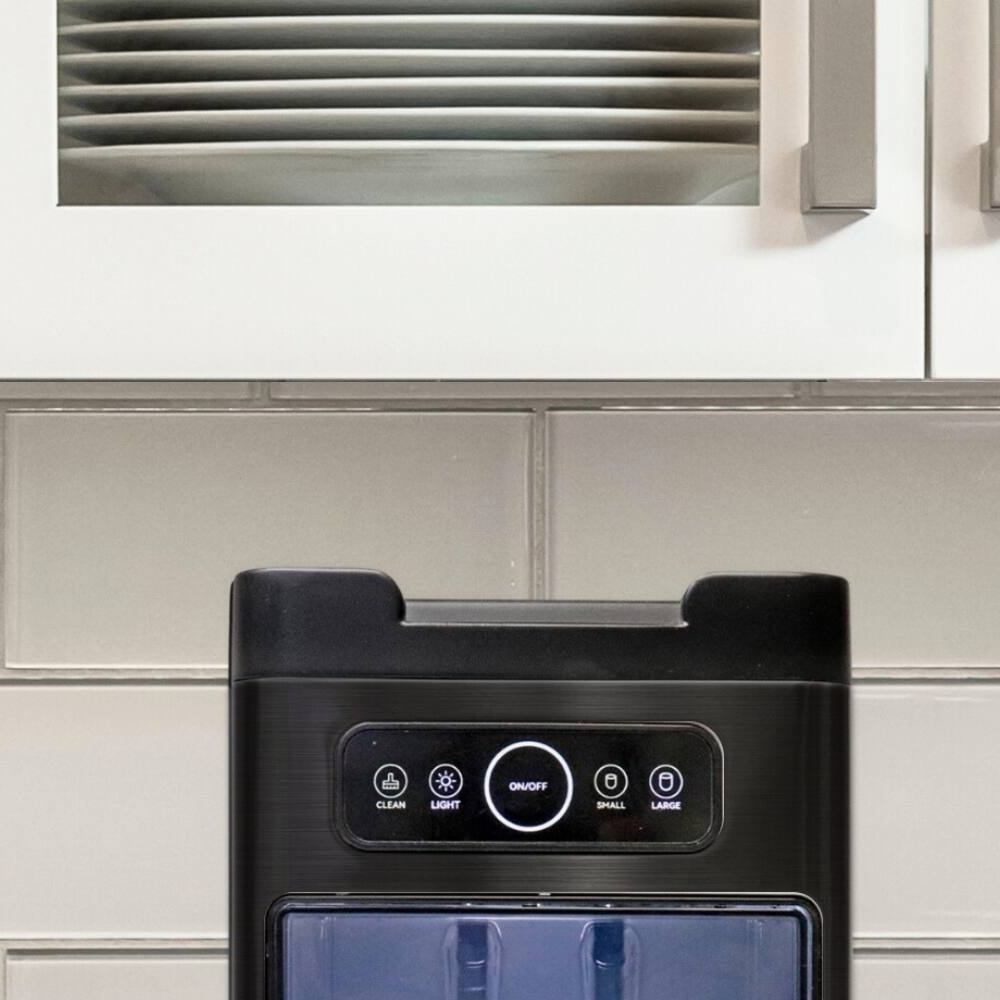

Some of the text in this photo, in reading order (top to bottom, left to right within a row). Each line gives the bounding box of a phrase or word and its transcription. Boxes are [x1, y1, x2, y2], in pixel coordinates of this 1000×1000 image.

[508, 781, 548, 791] ON/OFF
[375, 801, 406, 809] CLEAN
[430, 800, 461, 810] LIGHT
[596, 801, 626, 810] SMALL
[650, 801, 682, 810] LARGE
